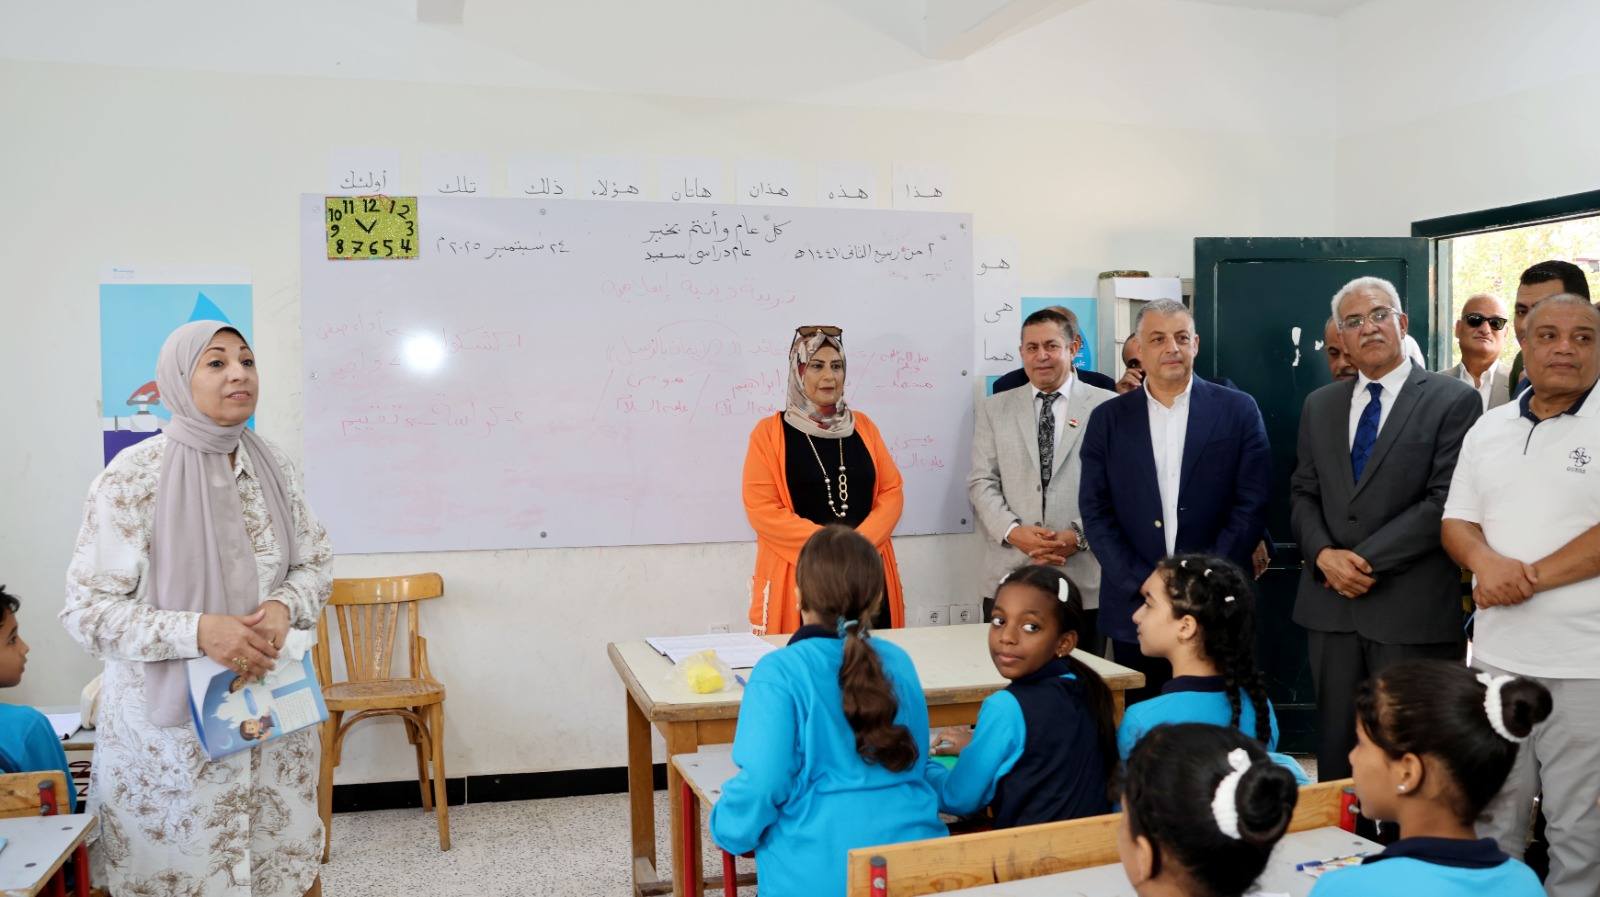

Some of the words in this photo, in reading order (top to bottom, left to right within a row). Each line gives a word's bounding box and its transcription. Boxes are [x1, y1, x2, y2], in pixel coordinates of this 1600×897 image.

[340, 169, 387, 192] أولئك
[438, 175, 477, 194] تلك
[524, 177, 564, 195] ذلك
[671, 177, 712, 201] هاتان
[749, 182, 789, 198] هذان
[828, 184, 869, 199] هذه
[905, 183, 943, 198] هذا
[342, 200, 354, 214] 11
[362, 198, 381, 213] 12
[389, 200, 396, 214] 1
[397, 204, 410, 220] 2
[328, 208, 343, 221] 10
[330, 224, 340, 238] 9
[405, 220, 414, 236] 3
[642, 223, 681, 243] بخير
[735, 213, 760, 242] عام
[336, 239, 344, 254] 8
[351, 240, 364, 254] 7
[369, 240, 378, 255] 6
[383, 239, 393, 256] 5
[400, 238, 412, 253] 4
[484, 240, 545, 259] سبتمبر
[549, 240, 571, 253] ٢٤
[732, 240, 752, 263] عام
[644, 250, 686, 263] سعيد
[975, 258, 1010, 276] هو
[984, 335, 1014, 362] هما
